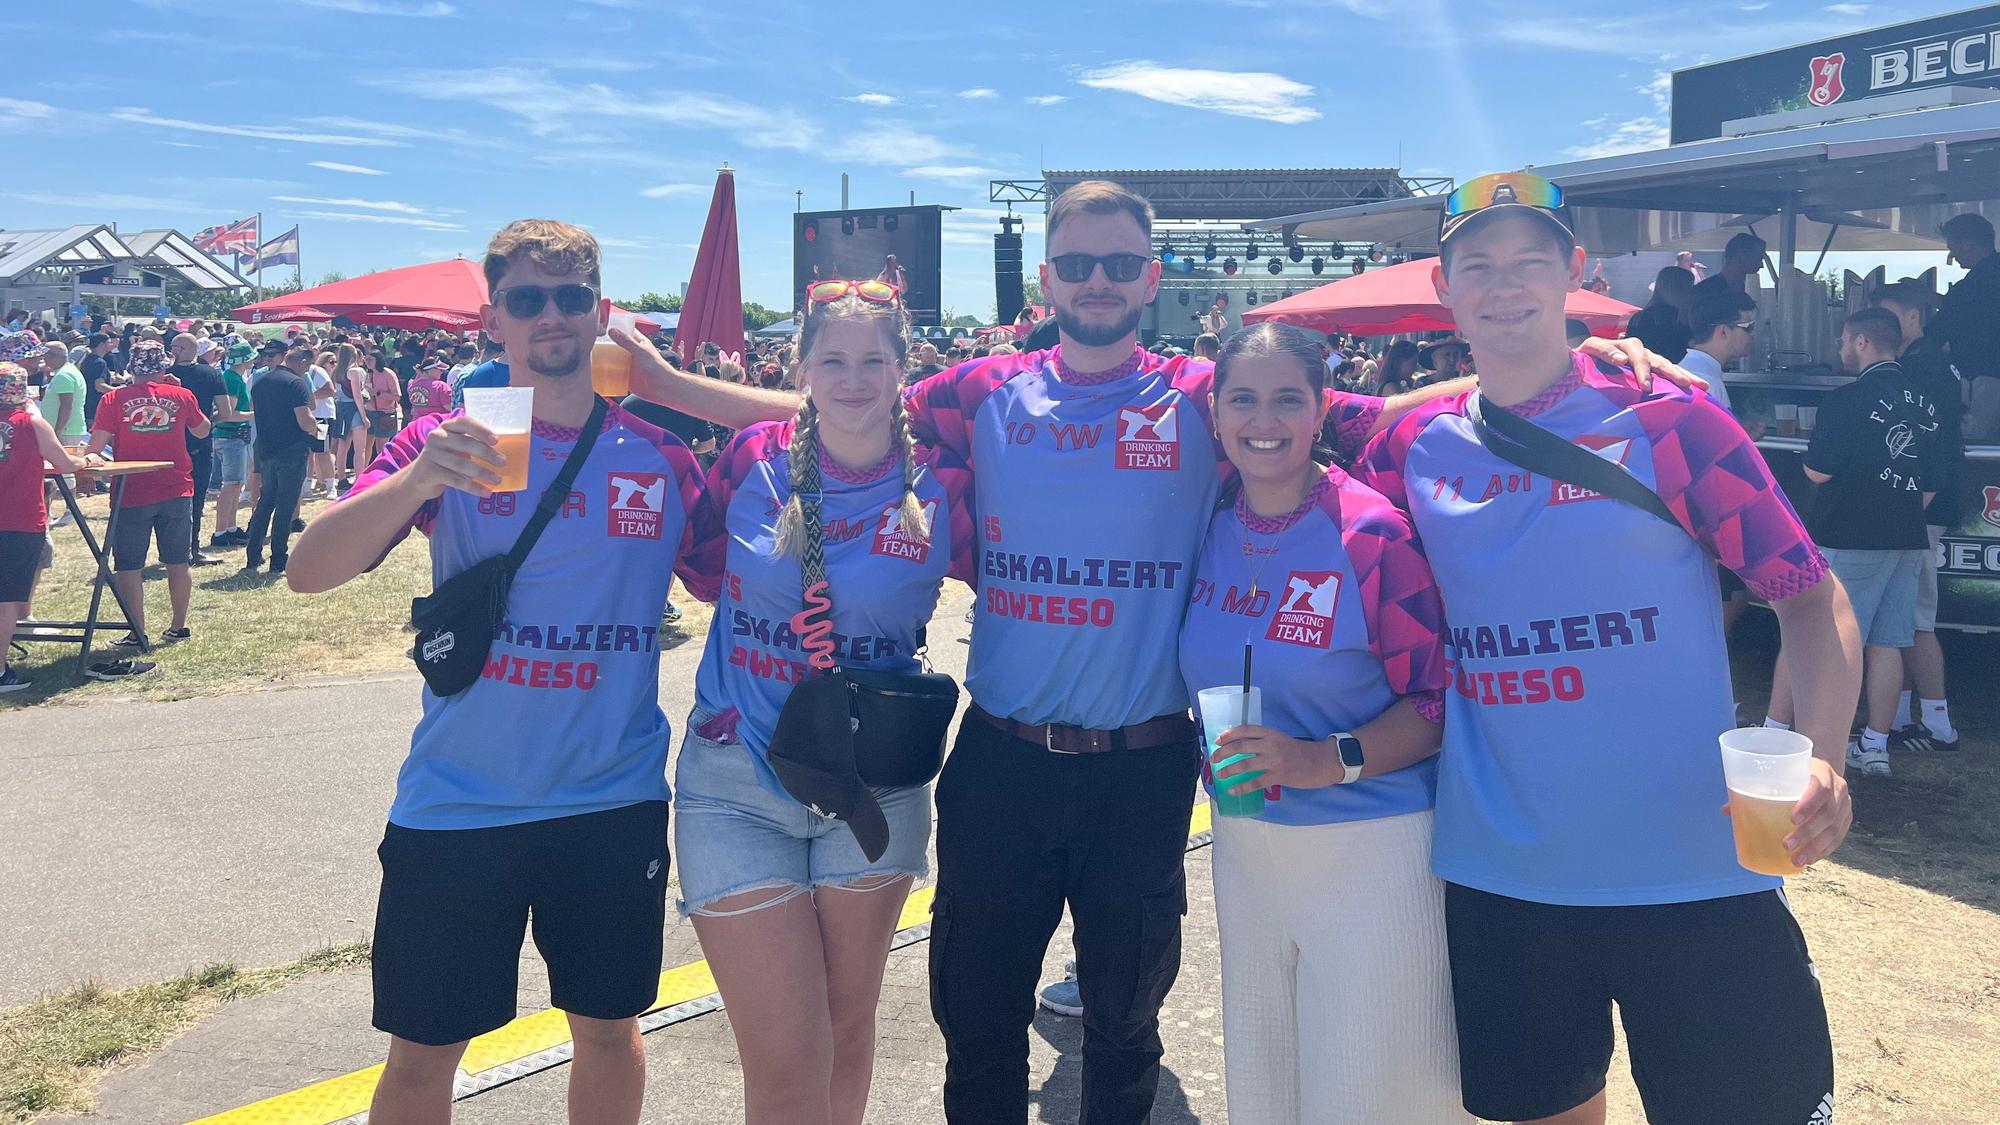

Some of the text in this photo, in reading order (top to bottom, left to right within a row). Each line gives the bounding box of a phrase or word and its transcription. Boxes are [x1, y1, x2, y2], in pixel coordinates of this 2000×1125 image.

[1006, 421, 1103, 451] 10 YW
[1125, 441, 1172, 453] DRINKING
[1125, 453, 1172, 469] TEAM
[1432, 475, 1464, 501] 11
[1880, 467, 1920, 491] STA
[477, 491, 515, 516] 89
[1558, 484, 1601, 501] TEA
[618, 511, 657, 522] DRINKING
[618, 520, 656, 537] TEAM
[984, 515, 1003, 542] ES
[881, 541, 922, 560] TEAM
[985, 549, 1183, 590] ESKALIERT
[986, 586, 1116, 628] SOWIESO
[1221, 585, 1271, 618] MD
[1279, 613, 1325, 628] DRINKING
[1276, 624, 1323, 645] TEAM
[482, 652, 598, 690] WIESO
